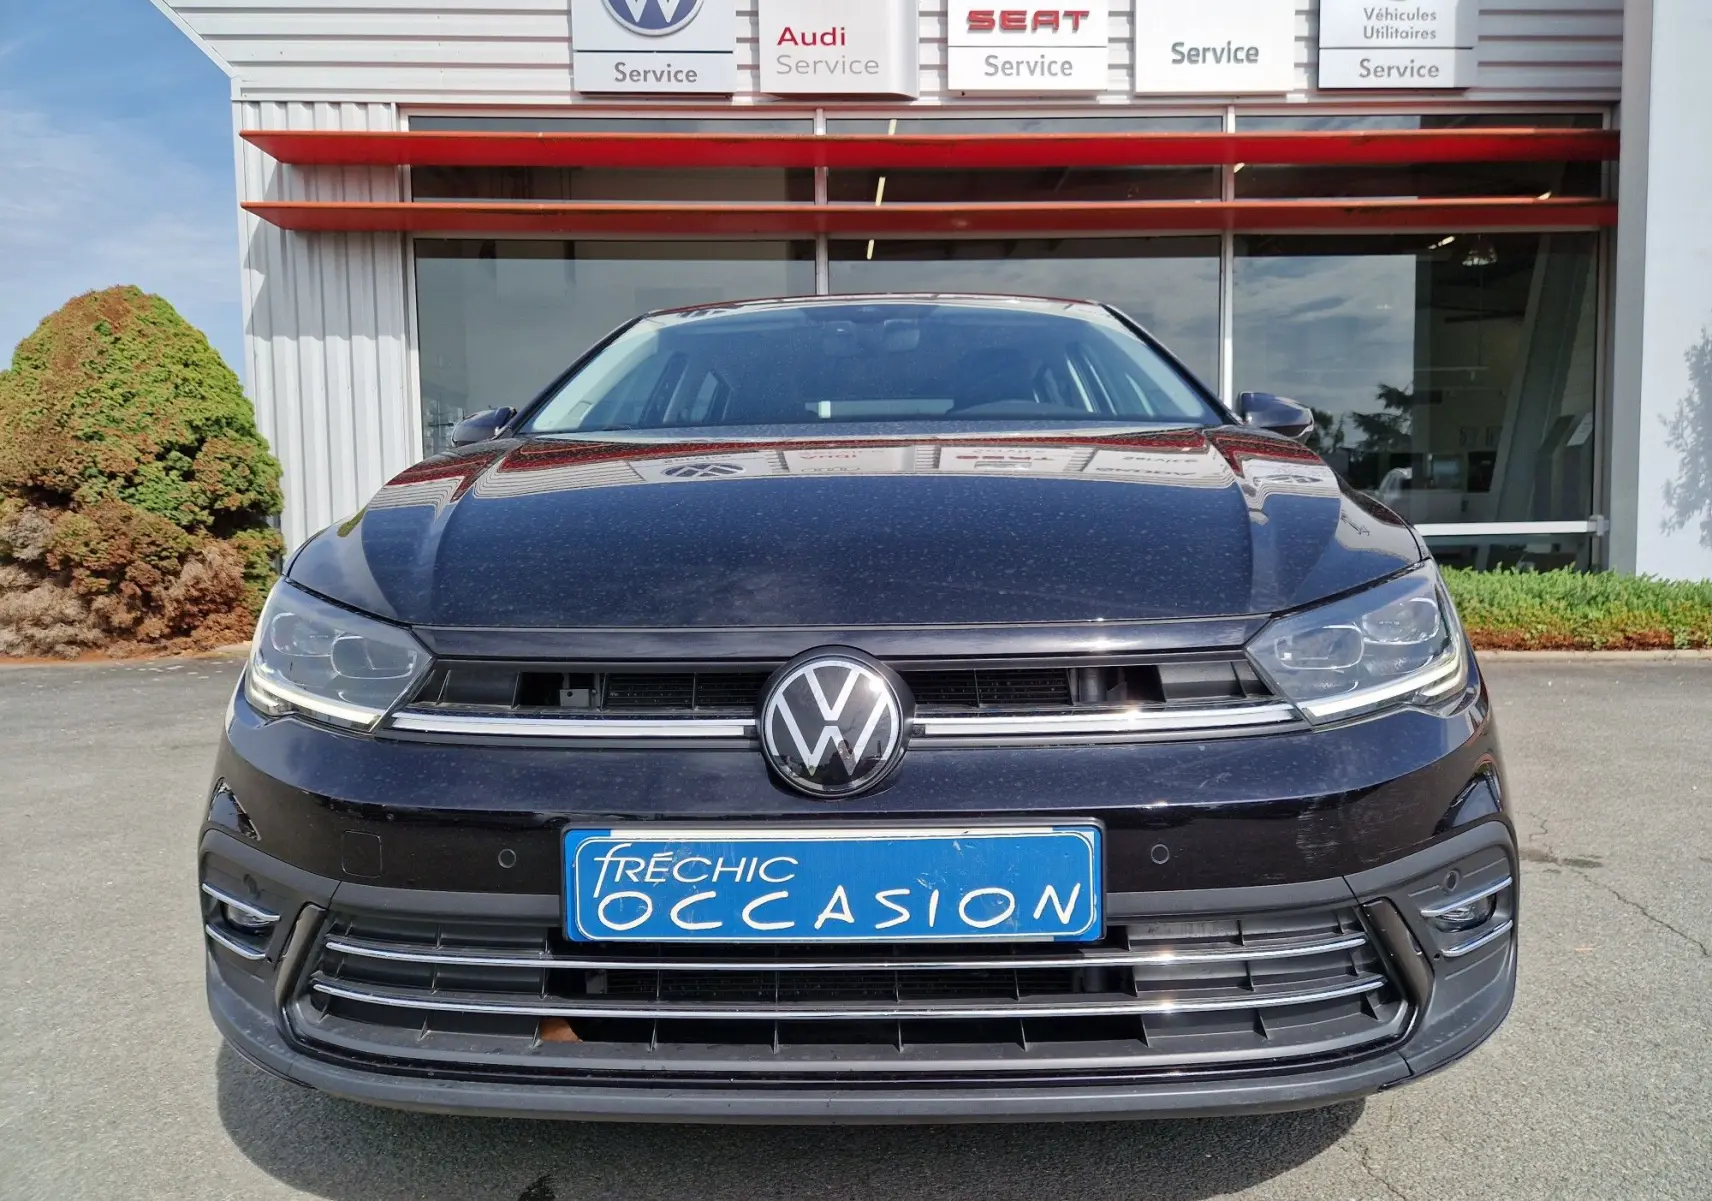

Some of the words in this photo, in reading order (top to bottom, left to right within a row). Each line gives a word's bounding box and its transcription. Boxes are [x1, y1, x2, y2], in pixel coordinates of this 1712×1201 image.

[967, 10, 1090, 33] SEAT
[1363, 7, 1437, 22] Véhicules
[776, 26, 846, 46] Audi
[1363, 25, 1437, 40] Utilitaires
[1170, 40, 1259, 64] Service
[614, 61, 698, 83] Service
[776, 54, 879, 75] Service
[984, 54, 1073, 77] Service
[1358, 58, 1440, 78] Service
[597, 883, 1082, 930] OCCASION
